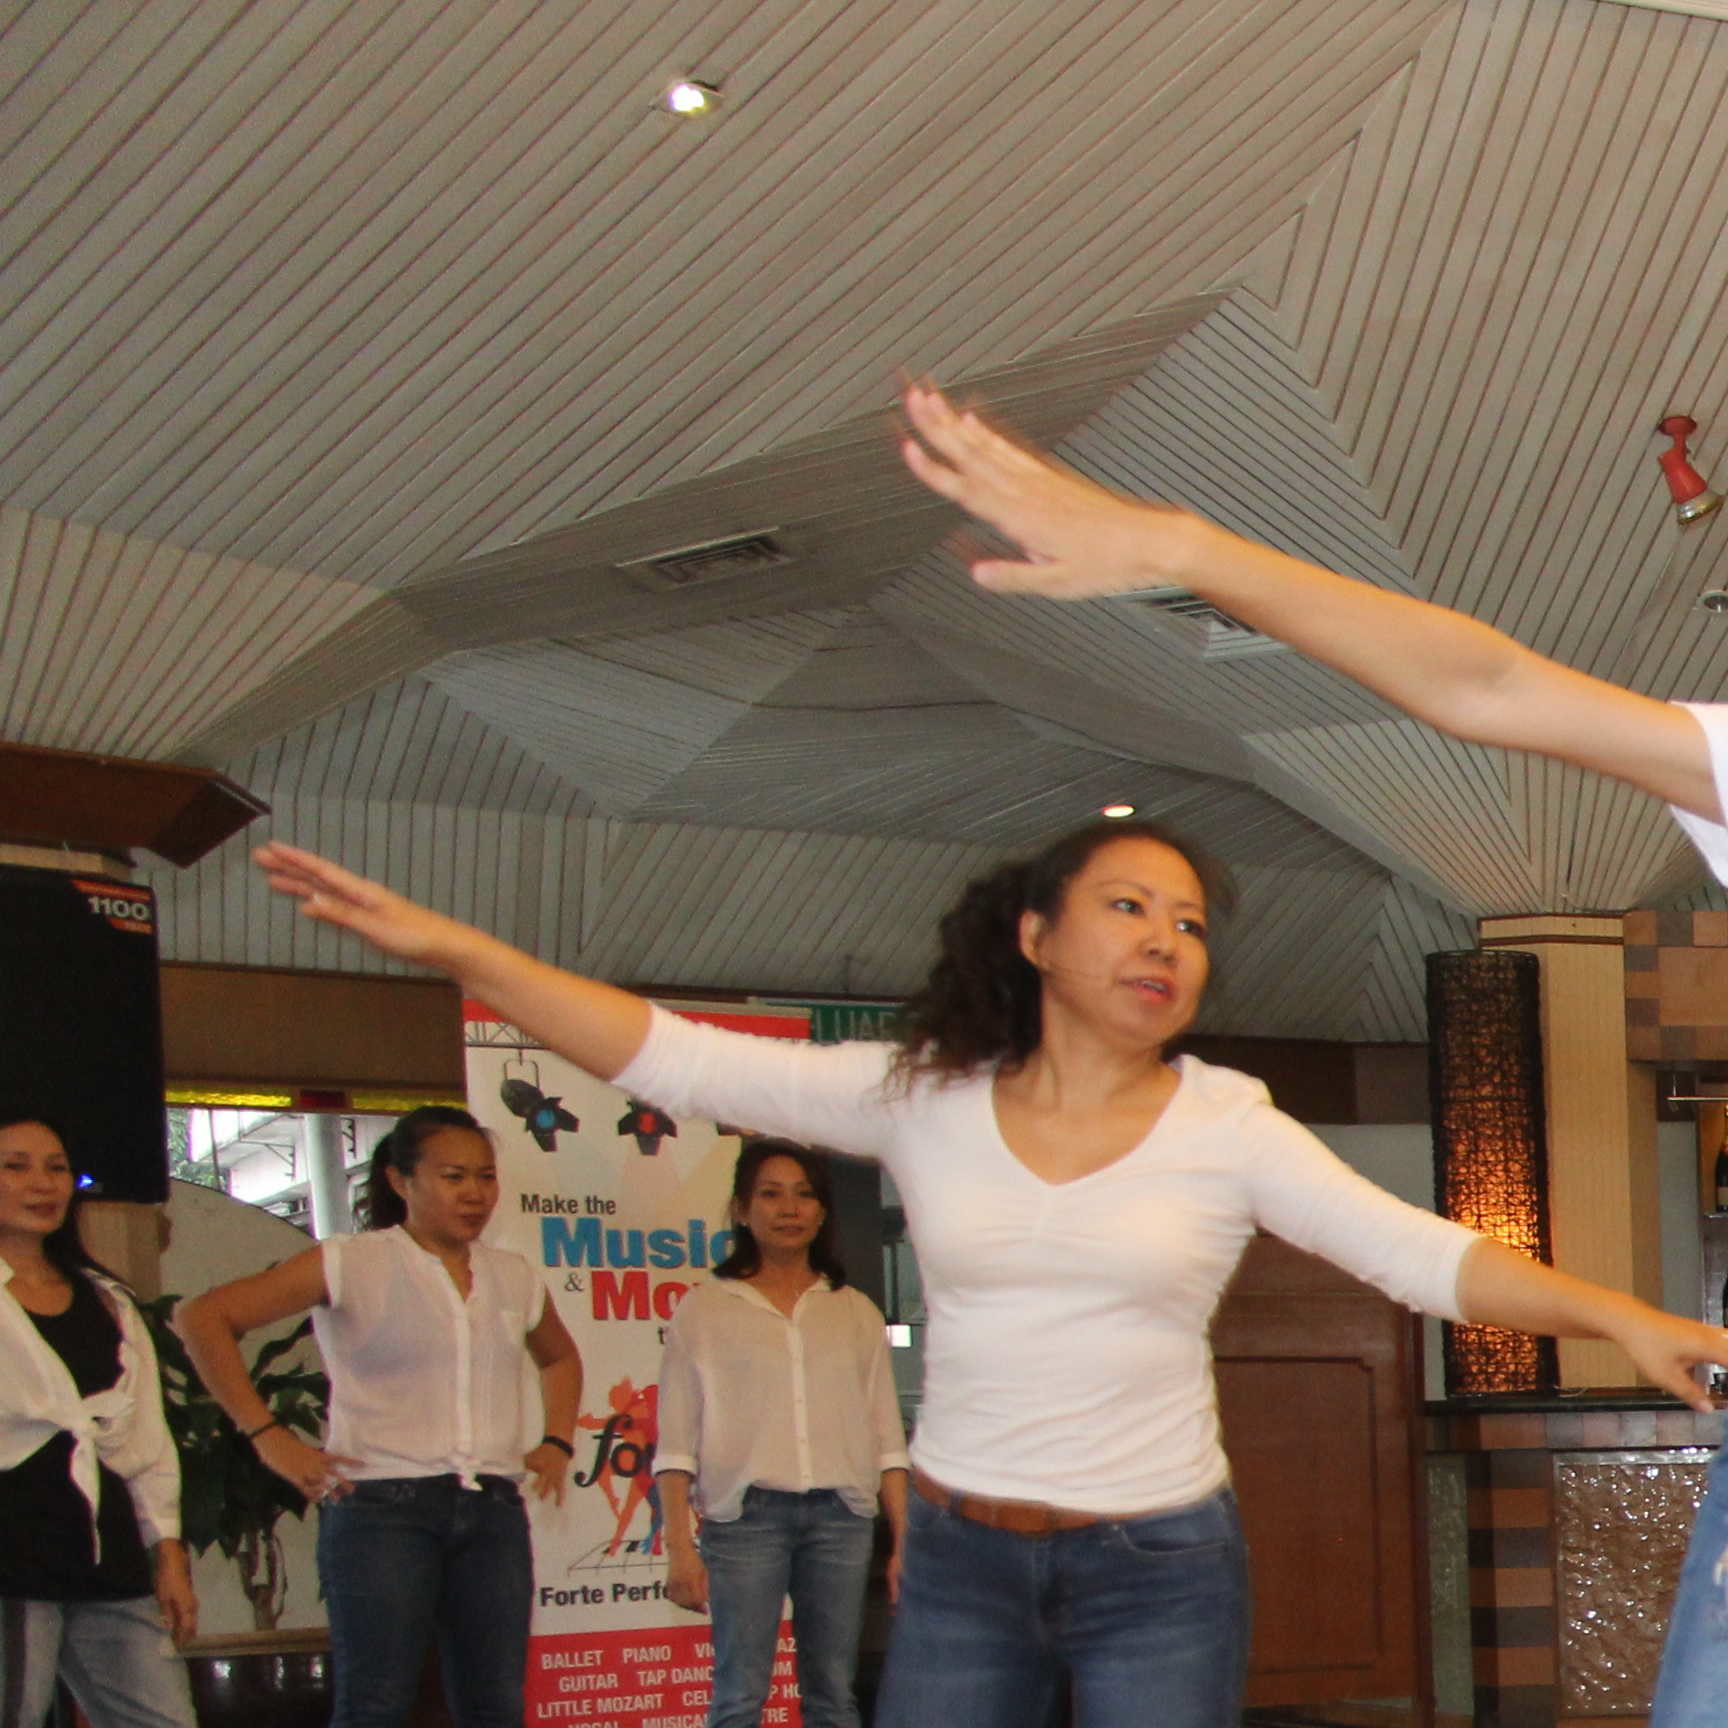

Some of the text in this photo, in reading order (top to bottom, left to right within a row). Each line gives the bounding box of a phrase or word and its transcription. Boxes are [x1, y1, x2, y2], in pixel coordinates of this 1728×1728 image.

[88, 896, 149, 920] 1100
[521, 1193, 616, 1215] Make the
[564, 1270, 700, 1321] & Mo
[540, 1585, 604, 1607] Forte
[542, 1650, 604, 1670] BALLET
[622, 1645, 672, 1664] PIANO
[559, 1673, 618, 1693] GUITAR
[637, 1668, 667, 1687] TAP
[671, 1665, 715, 1685] DANC
[537, 1699, 593, 1719] LITTLE
[597, 1693, 664, 1713] MOZART
[682, 1689, 713, 1707] CEL
